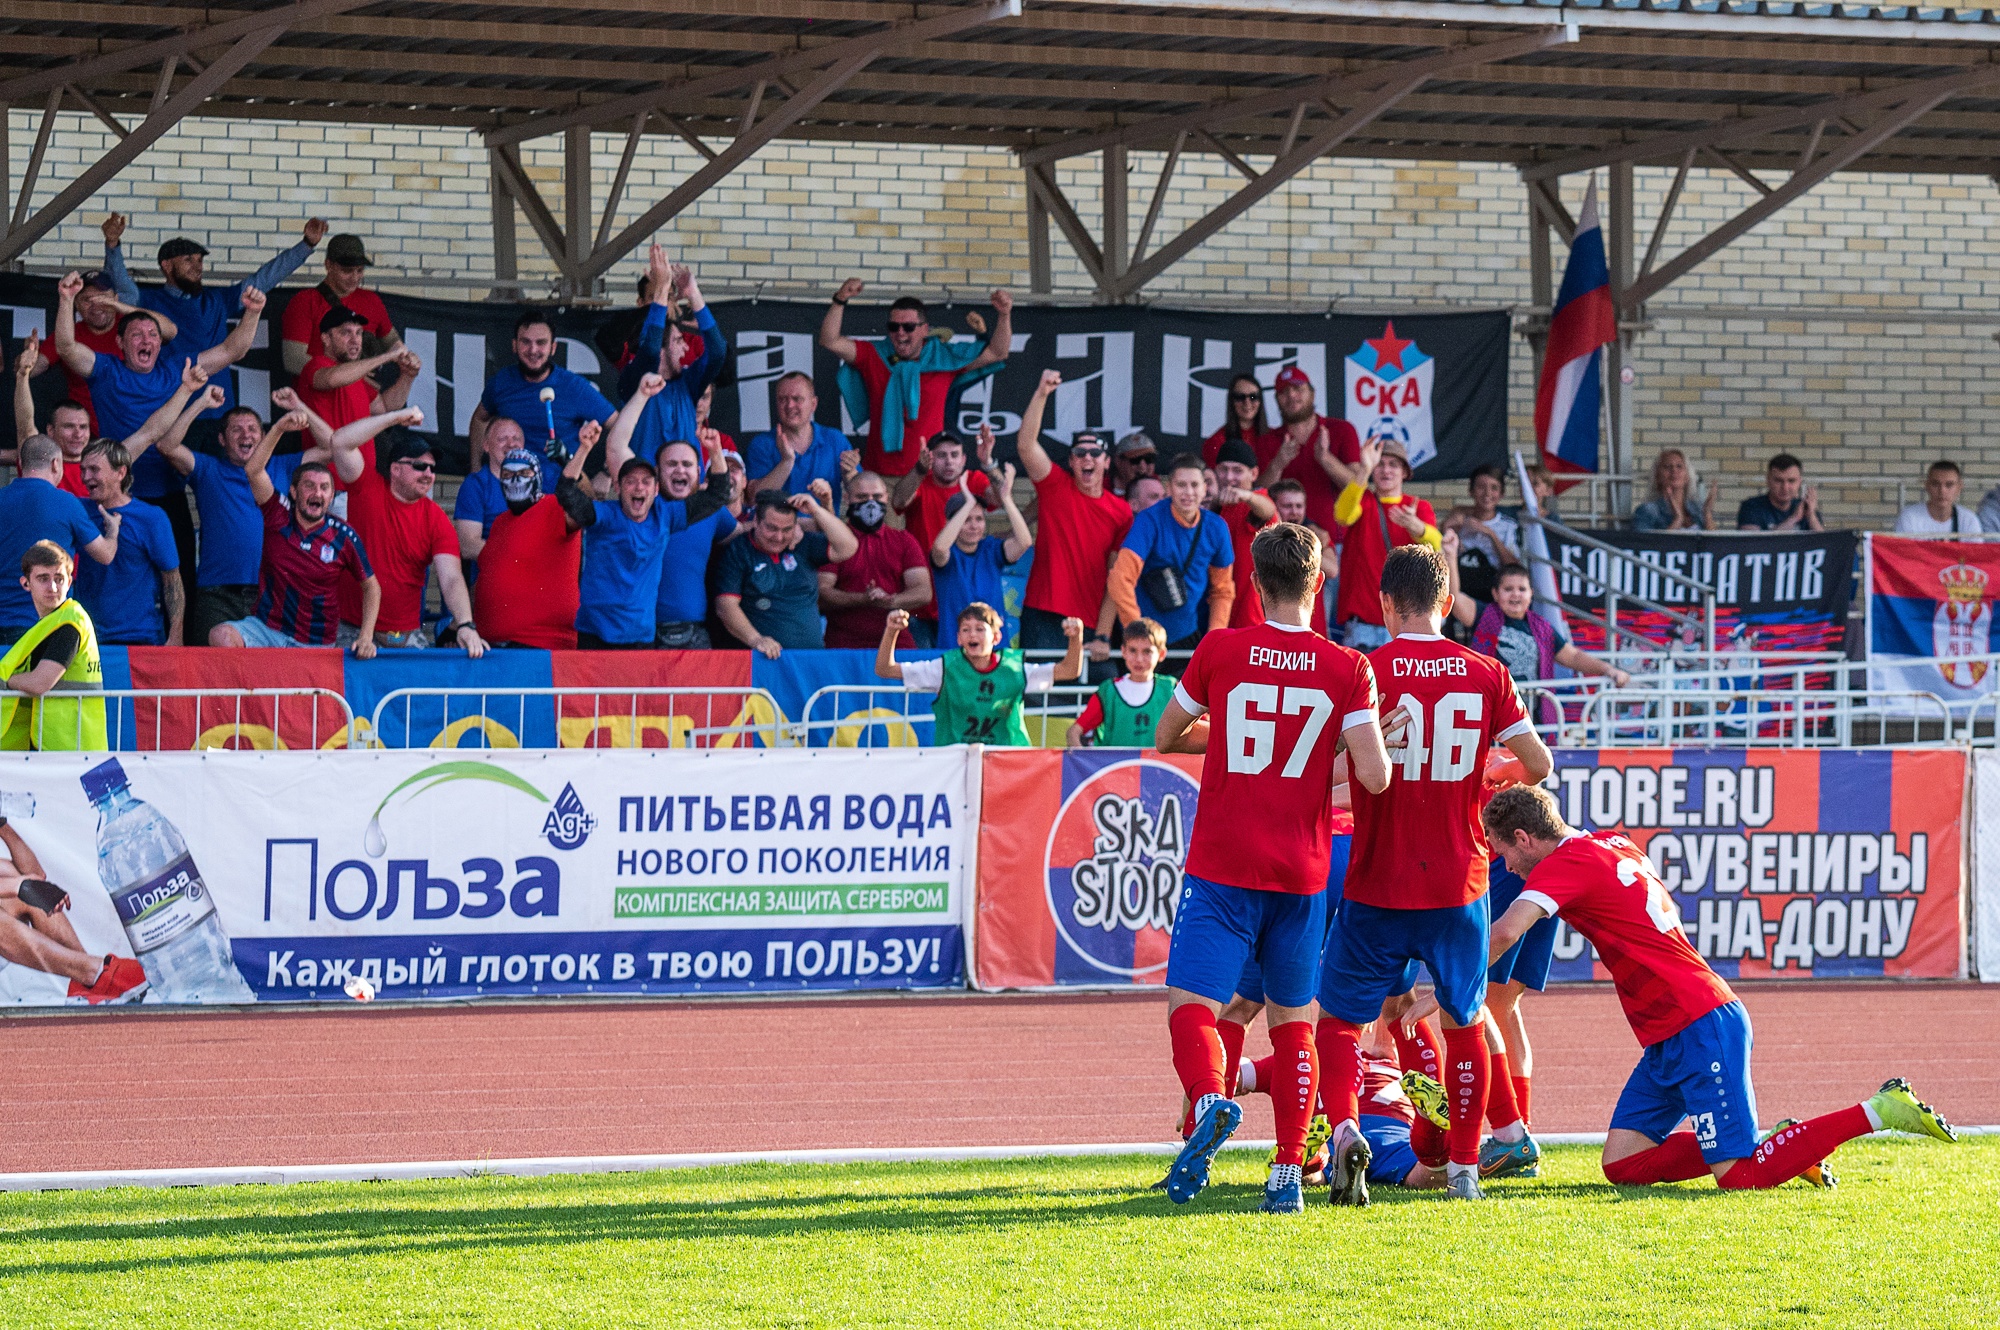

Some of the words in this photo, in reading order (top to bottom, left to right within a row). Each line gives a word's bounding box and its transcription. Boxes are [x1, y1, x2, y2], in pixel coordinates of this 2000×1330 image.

[1355, 376, 1420, 415] СКА
[1249, 645, 1316, 671] ЕРОХИН
[1392, 656, 1467, 677] СУХАРЕВ
[1226, 682, 1334, 778] 67
[1388, 692, 1483, 781] 46
[619, 795, 832, 832] ПИТЬЕВАЯ
[843, 793, 952, 838] ВОДА
[264, 838, 560, 921] Польза
[617, 848, 748, 876] НОВОГО
[758, 845, 950, 873] ПОКОЛЕНИЯ
[1648, 833, 1927, 893] СУВЕНИРЫ
[617, 891, 760, 914] КОМПЛЕКСНАЯ
[765, 890, 842, 914] ЗАЩИТА
[846, 888, 944, 911] СЕРЕБРОМ
[1072, 852, 1184, 933] STOR
[266, 946, 448, 992] Каждый
[459, 953, 602, 984] глоток
[612, 952, 636, 981] в
[647, 950, 753, 980] твою
[765, 937, 942, 977] ПОЛЬЗУ!
